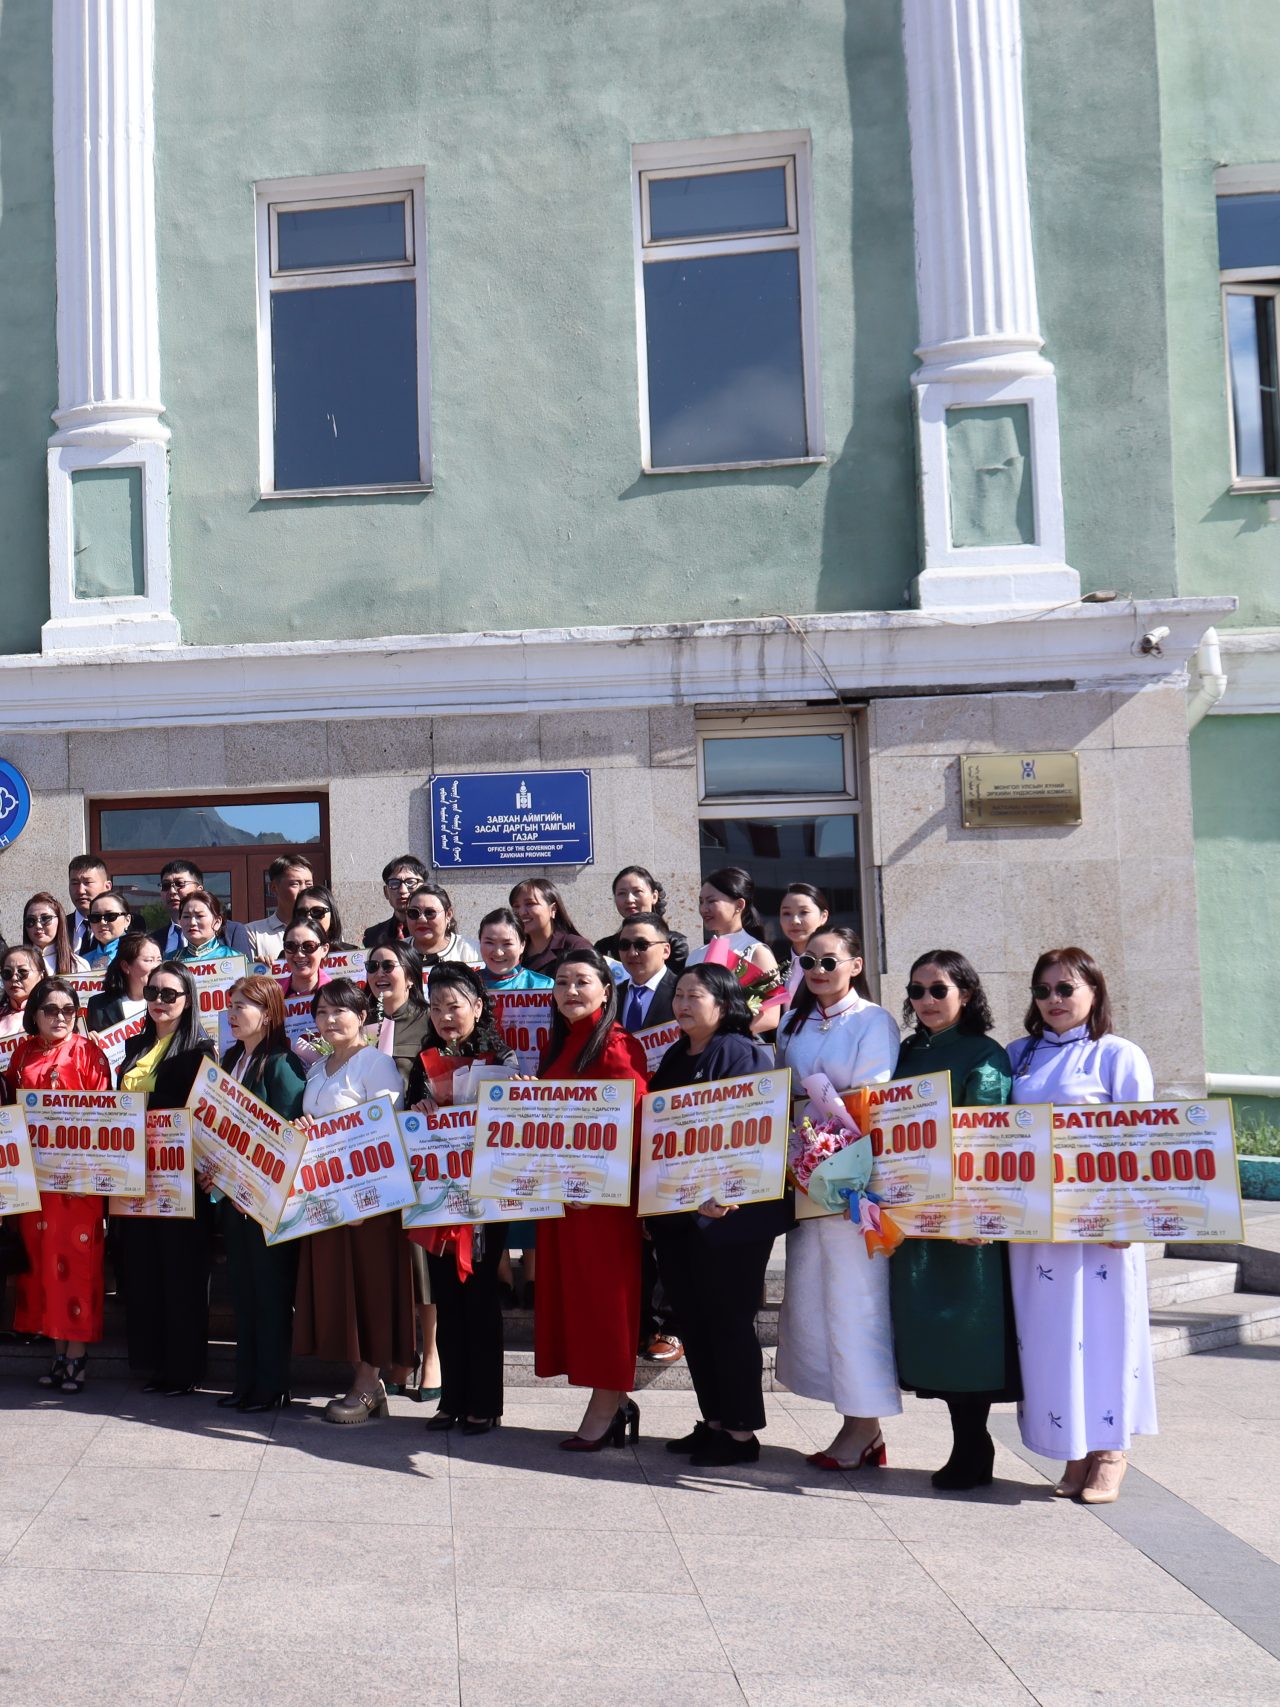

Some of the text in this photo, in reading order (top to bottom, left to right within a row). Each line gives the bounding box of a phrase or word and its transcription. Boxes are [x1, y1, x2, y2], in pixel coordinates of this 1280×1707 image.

[474, 822, 576, 834] ЗАСАГ ДАРГЫН ТАМГЫН
[487, 812, 562, 824] ЗАВХАН АЙМГИЙН
[512, 834, 538, 842] ГАЗАР
[98, 1017, 146, 1050] АТЛАМ
[642, 1026, 680, 1050] ТЛАМ
[42, 1094, 117, 1108] БАТЛАМЖ
[509, 1086, 598, 1101] БАТЛАМЖ
[670, 1082, 754, 1110] БАТЛАМЖ
[219, 1078, 282, 1136] БАТЛАМЖ
[426, 1110, 478, 1130] БАТЛ
[1052, 1108, 1180, 1129] БАТЛАМЖ
[28, 1124, 134, 1152] 20.000.000
[194, 1097, 286, 1184] 20.000.000
[487, 1121, 618, 1151] 20.000.000
[652, 1116, 772, 1160] 20.000.000
[410, 1150, 472, 1182] 20.00
